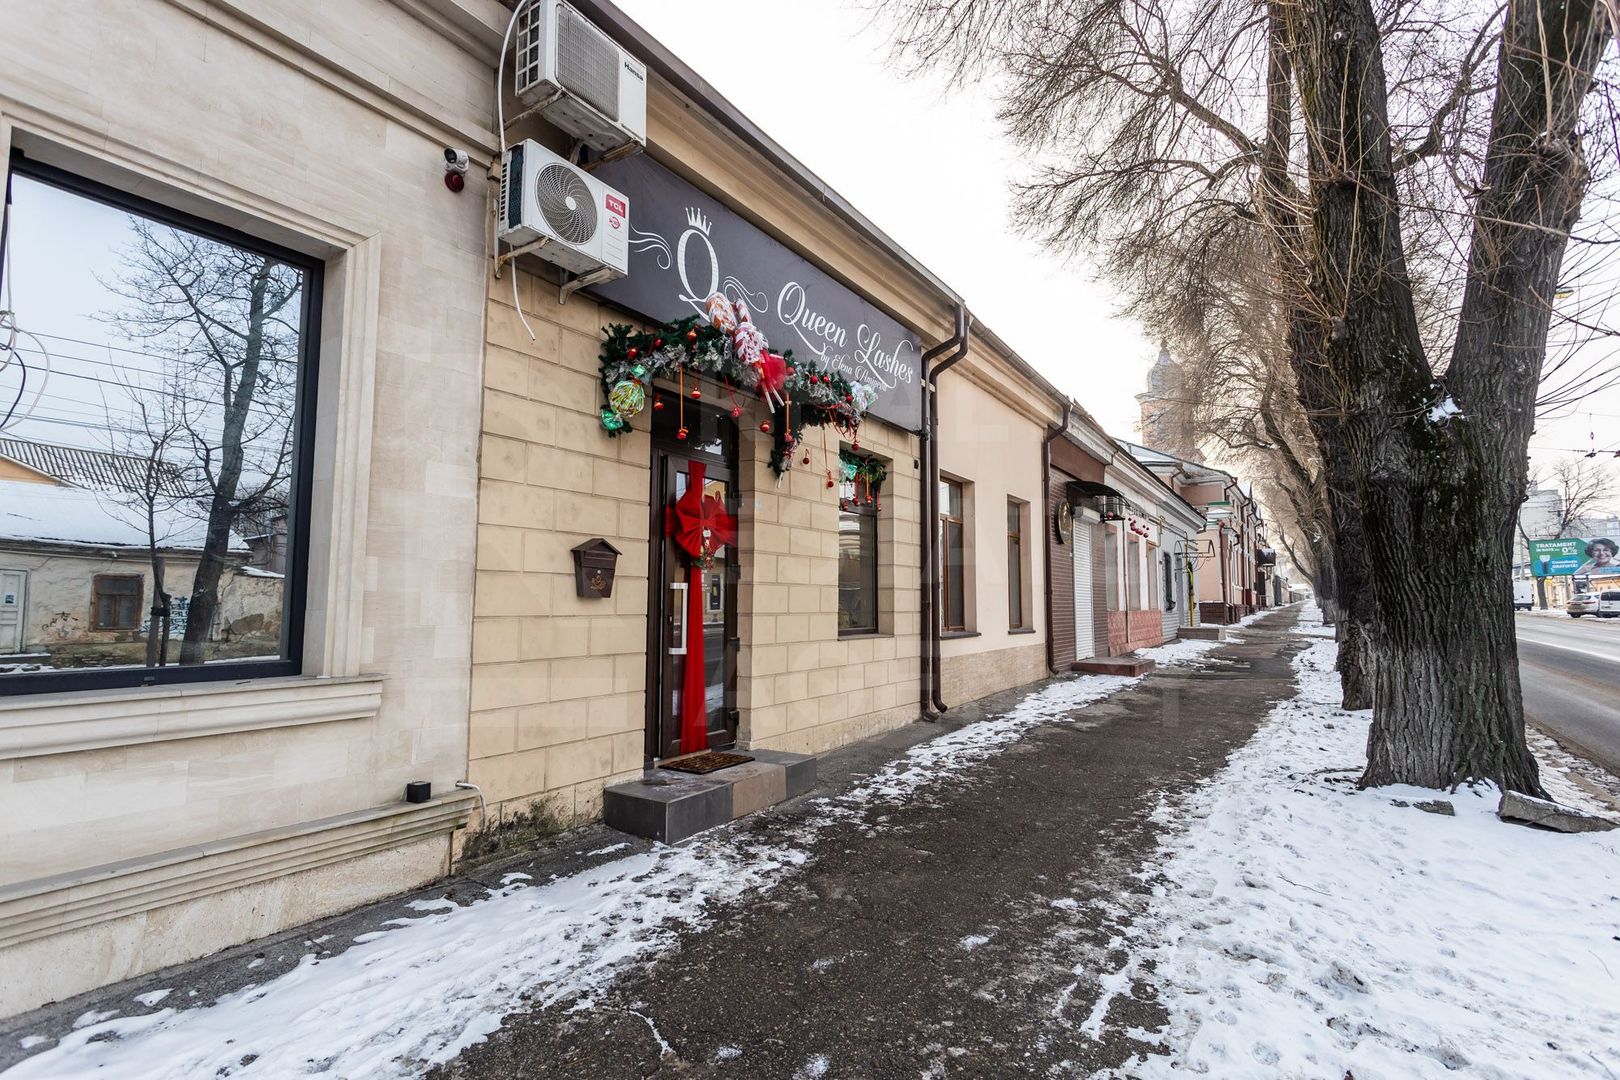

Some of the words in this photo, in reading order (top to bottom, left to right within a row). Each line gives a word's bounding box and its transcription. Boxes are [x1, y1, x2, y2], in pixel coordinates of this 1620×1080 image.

[624, 61, 644, 81] Hansa
[608, 199, 624, 213] TCL
[777, 281, 848, 355] Queen
[854, 324, 914, 388] Lashes
[820, 342, 834, 375] by
[832, 354, 853, 375] Elena
